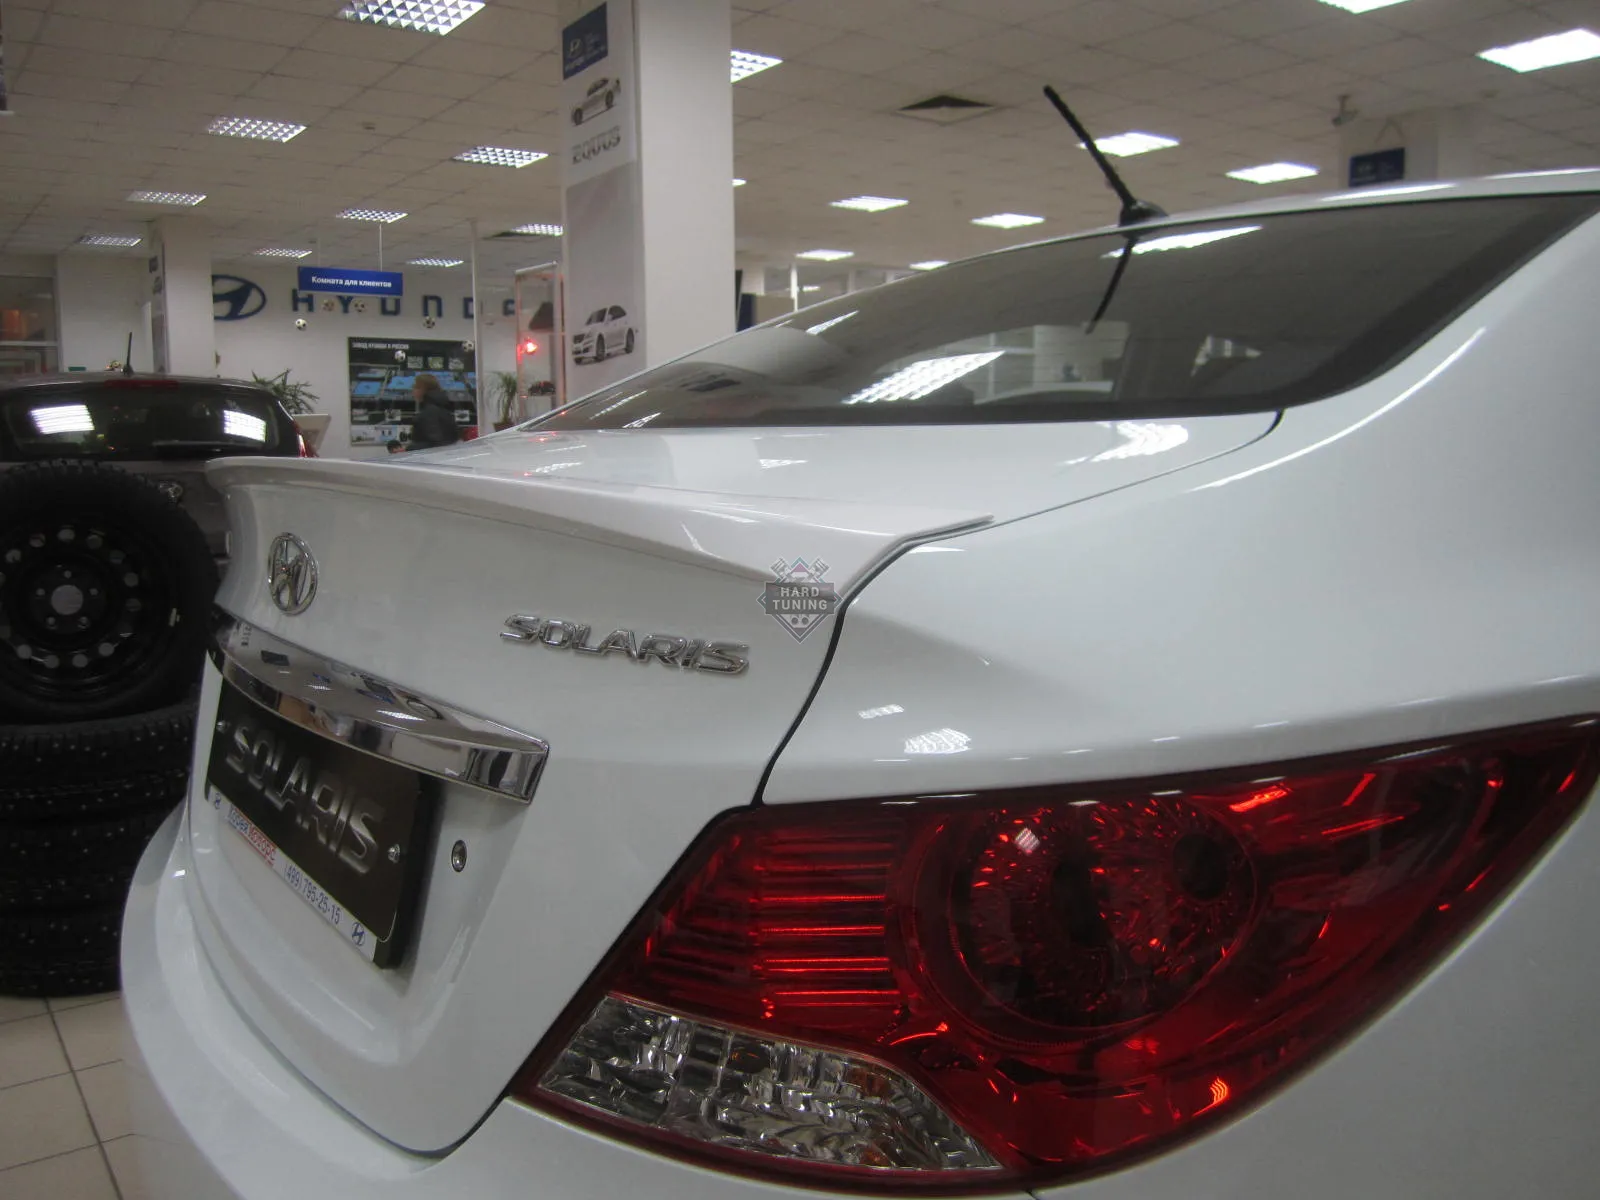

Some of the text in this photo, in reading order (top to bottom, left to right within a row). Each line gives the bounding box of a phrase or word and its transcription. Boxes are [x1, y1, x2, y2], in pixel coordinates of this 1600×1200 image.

[311, 275, 392, 288] Комната для клиентов
[500, 612, 750, 675] SOLARIS
[226, 724, 385, 875] SOLARIS
